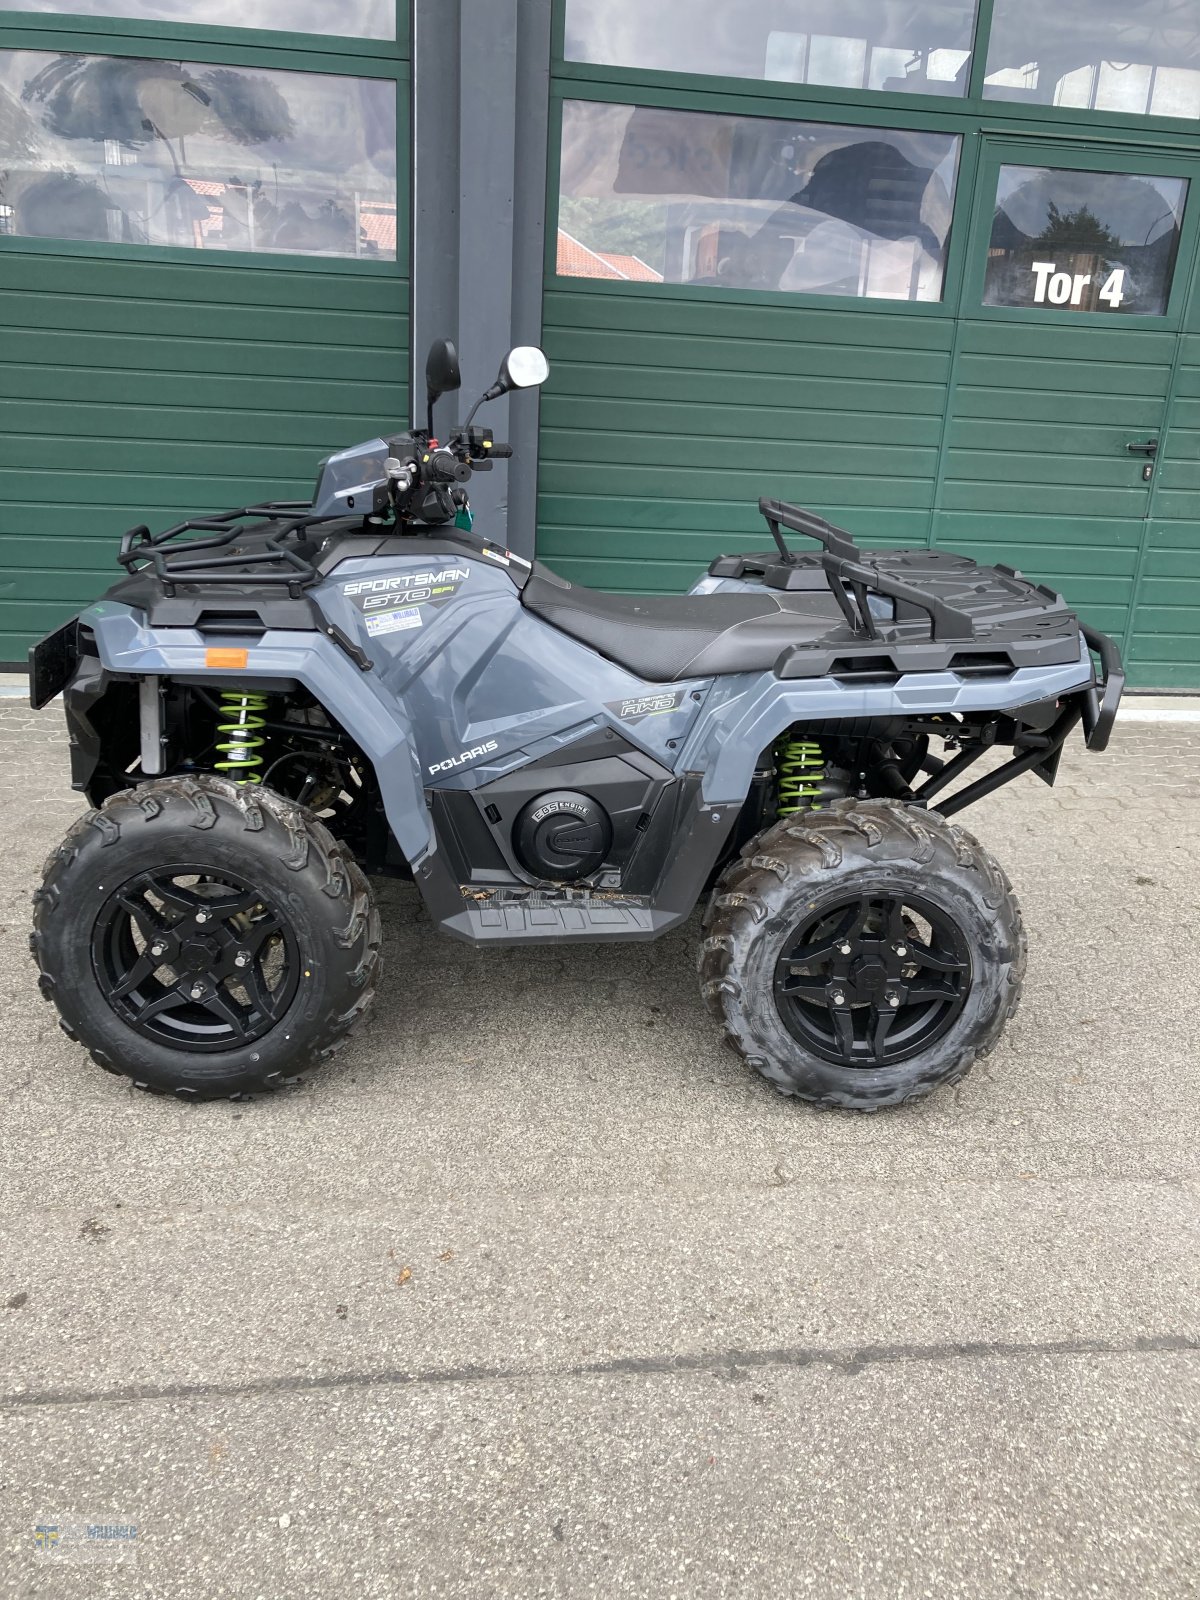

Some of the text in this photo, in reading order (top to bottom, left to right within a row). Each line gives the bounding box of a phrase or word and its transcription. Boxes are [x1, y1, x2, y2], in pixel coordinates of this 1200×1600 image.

[1032, 261, 1125, 308] Tor 4
[343, 568, 470, 595] SPORTSMAN
[363, 586, 454, 609] 570 EFI
[621, 698, 675, 716] AWD
[428, 740, 498, 775] POLARIS
[534, 802, 558, 820] EBS
[560, 802, 589, 814] ENGINE
